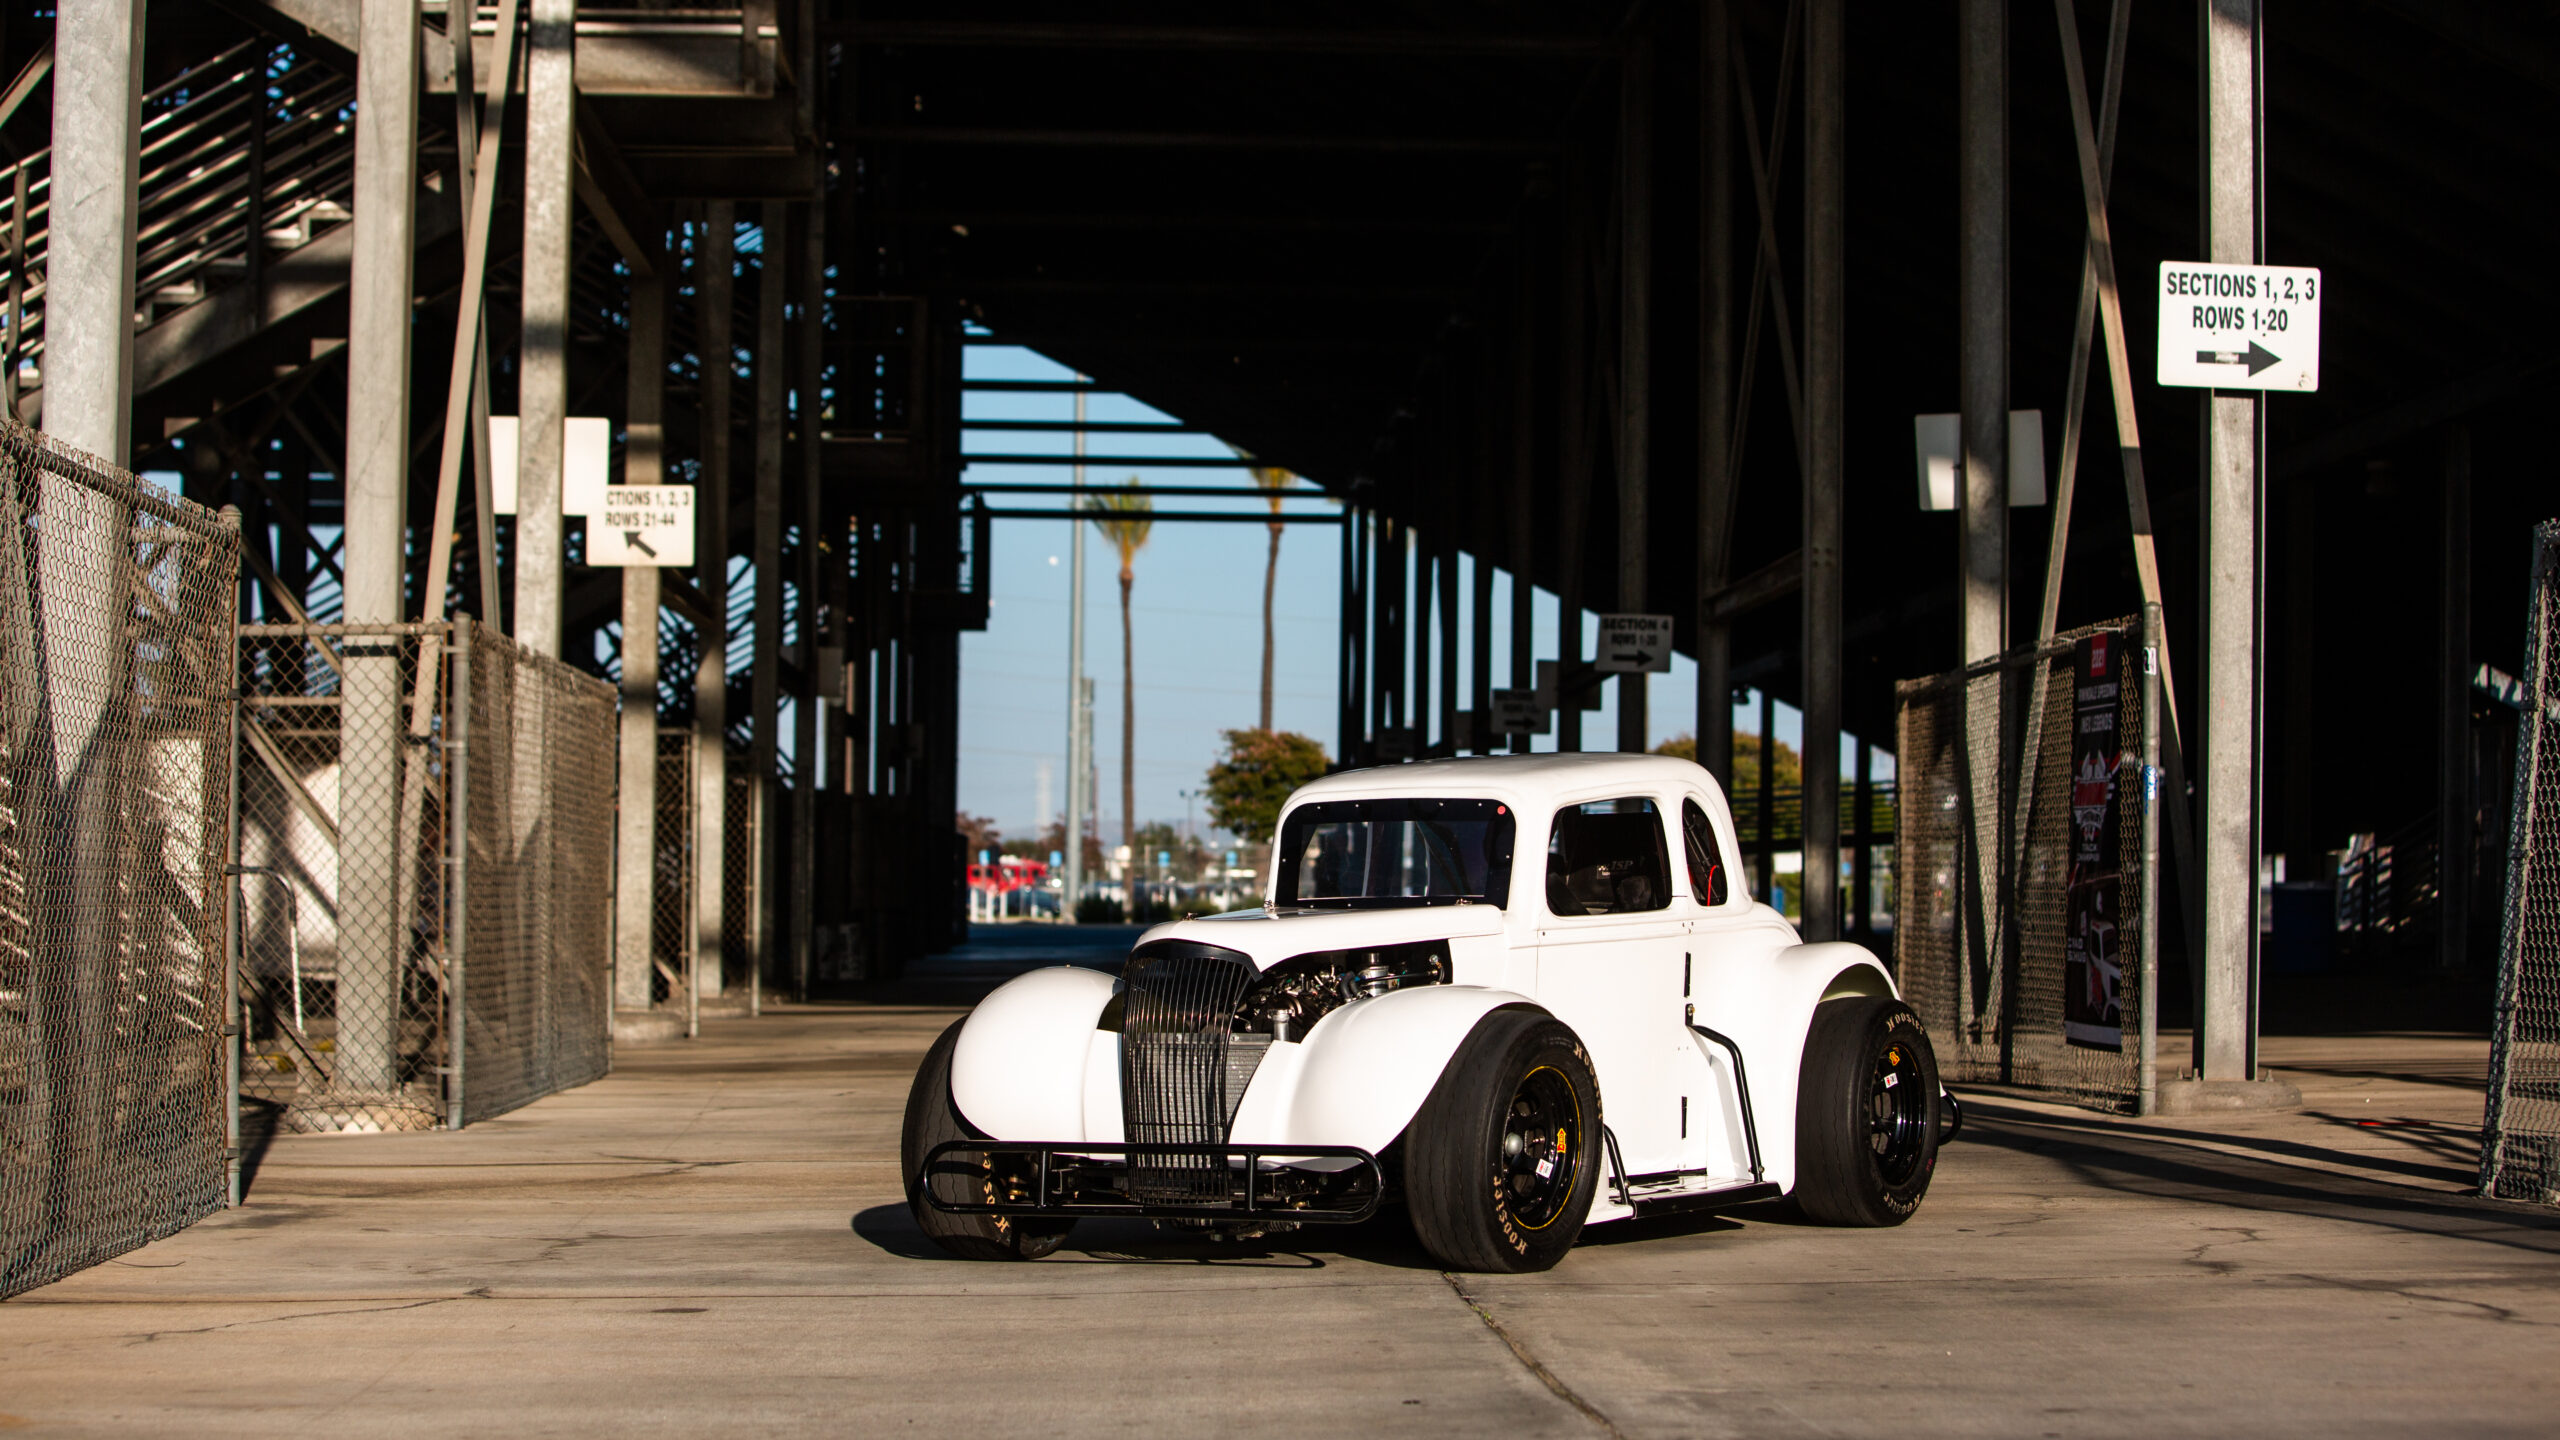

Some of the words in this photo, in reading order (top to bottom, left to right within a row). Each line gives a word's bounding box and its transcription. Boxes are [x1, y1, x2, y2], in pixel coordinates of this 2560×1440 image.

[2166, 271, 2257, 299] SECTIONS
[2263, 276, 2278, 304] 1,
[2283, 277, 2299, 304] 2,
[2305, 277, 2316, 301] 3
[2192, 305, 2245, 330] ROWS
[2251, 308, 2289, 332] 1-20
[606, 490, 650, 506] CTIONS
[655, 491, 665, 508] 1,
[668, 490, 679, 507] 2,
[682, 490, 690, 506] 3
[605, 511, 640, 527] ROWS
[643, 511, 675, 527] 21-44
[1602, 617, 1657, 631] SECTION
[1661, 619, 1669, 631] 4
[1611, 633, 1636, 646] ROWS
[1886, 1012, 1924, 1035] Hoosier
[1493, 1175, 1528, 1256] Hoosier
